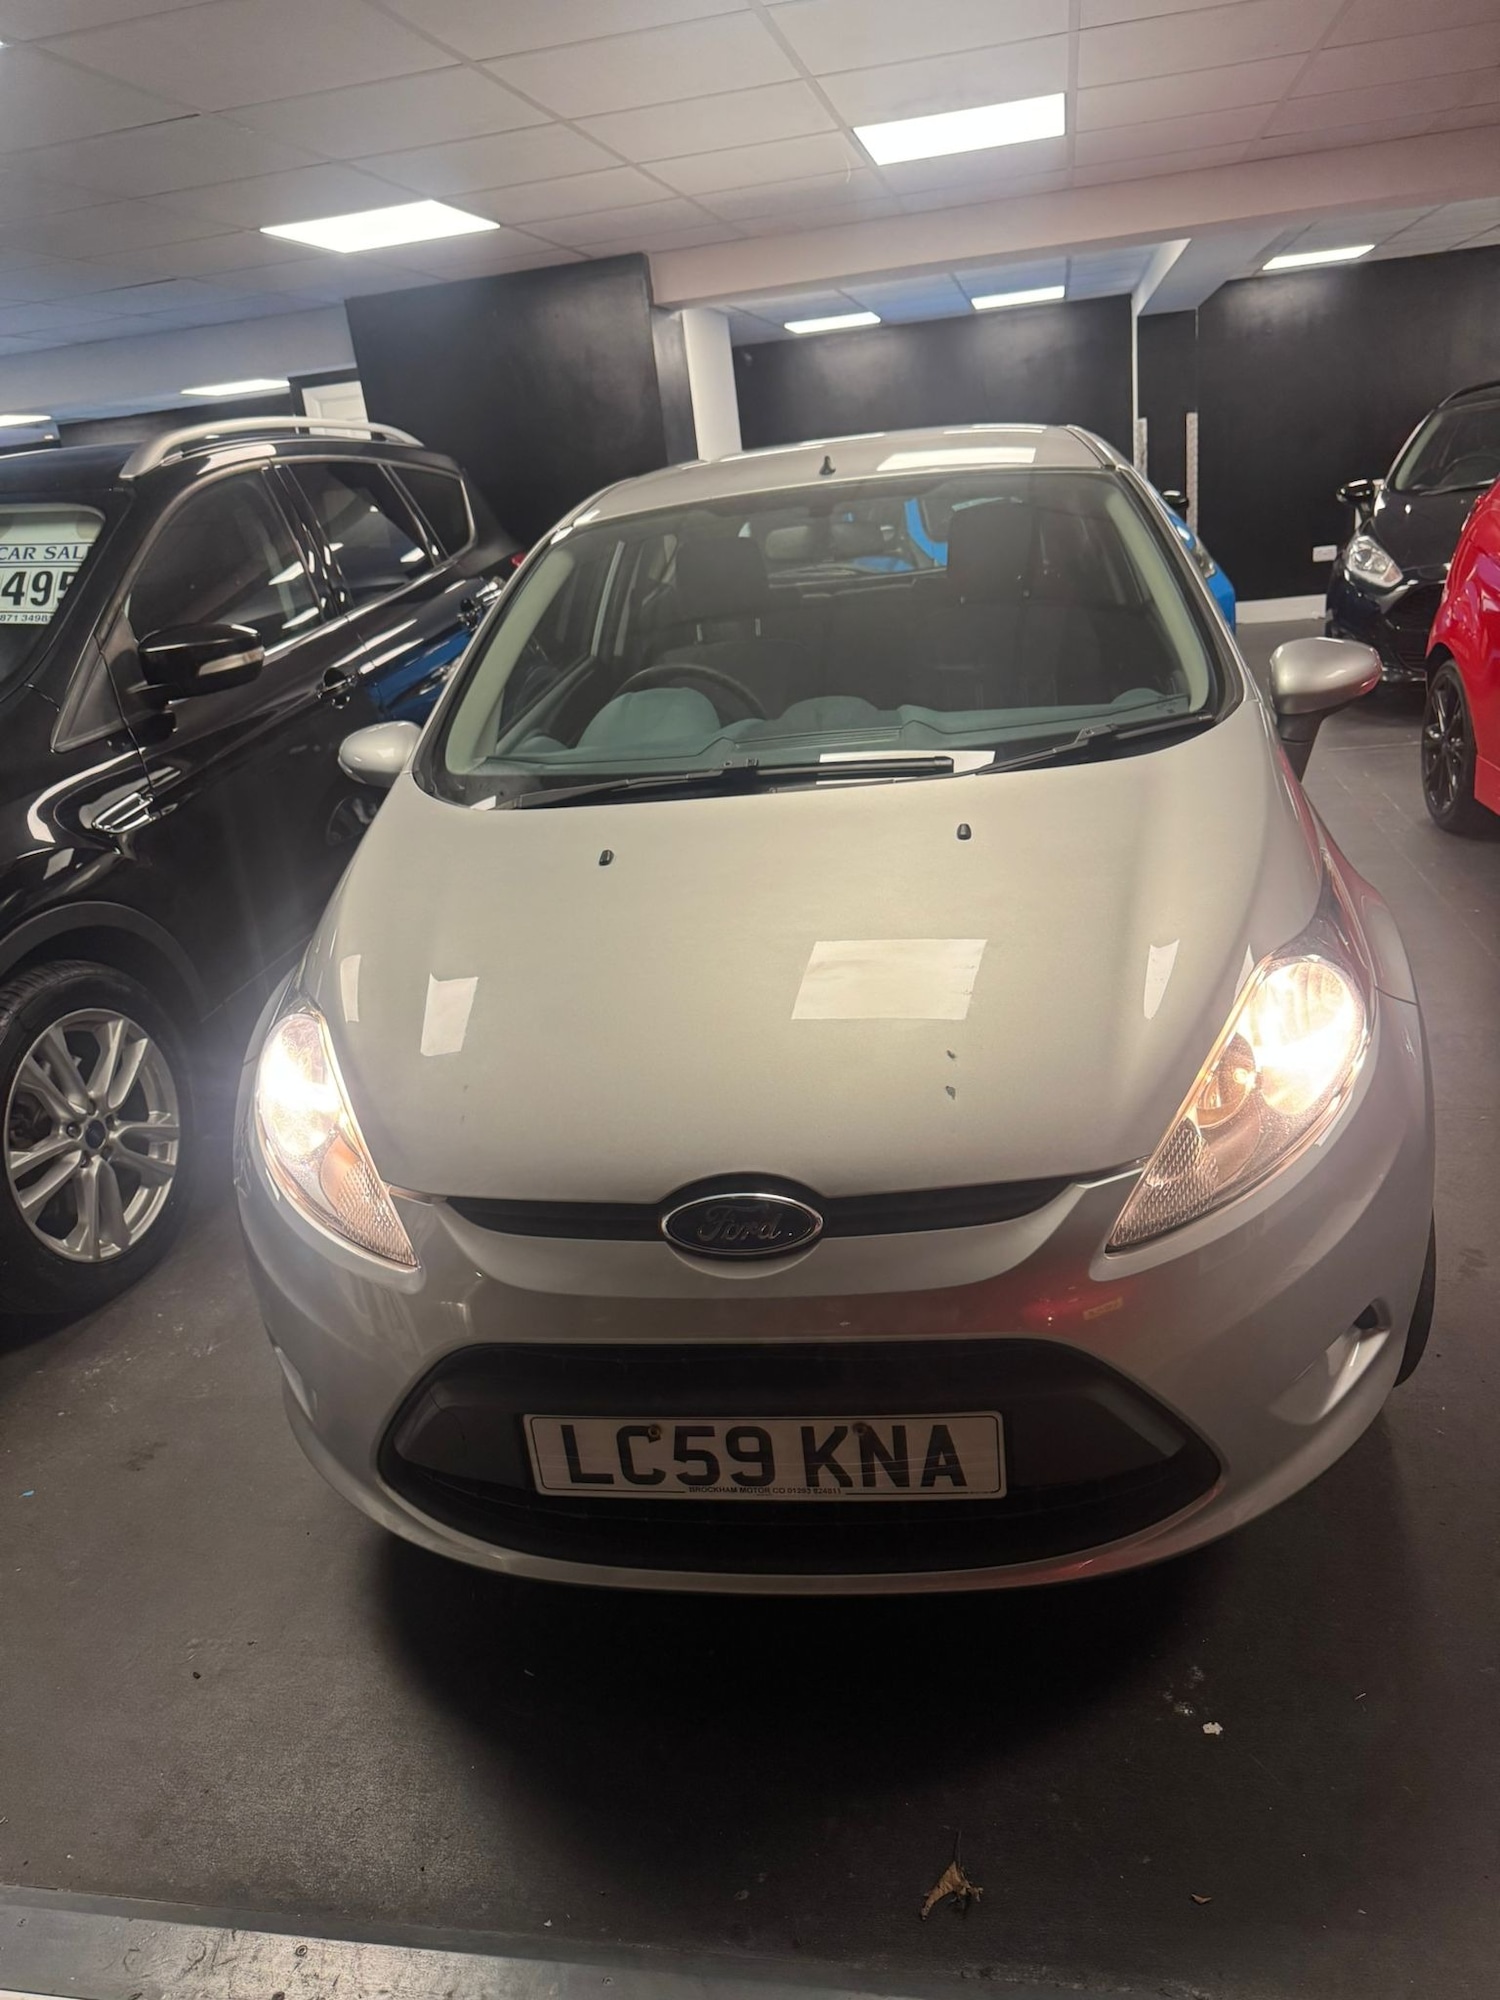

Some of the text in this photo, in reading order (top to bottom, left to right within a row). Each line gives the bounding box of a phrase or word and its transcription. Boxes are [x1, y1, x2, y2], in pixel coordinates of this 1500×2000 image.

[0, 545, 89, 560] CAR SAL
[21, 614, 48, 622] 3498
[697, 1203, 782, 1242] Ford
[560, 1423, 967, 1488] LC59 KNA
[688, 1486, 738, 1494] BROCKHAM
[739, 1487, 771, 1495] MOTOR
